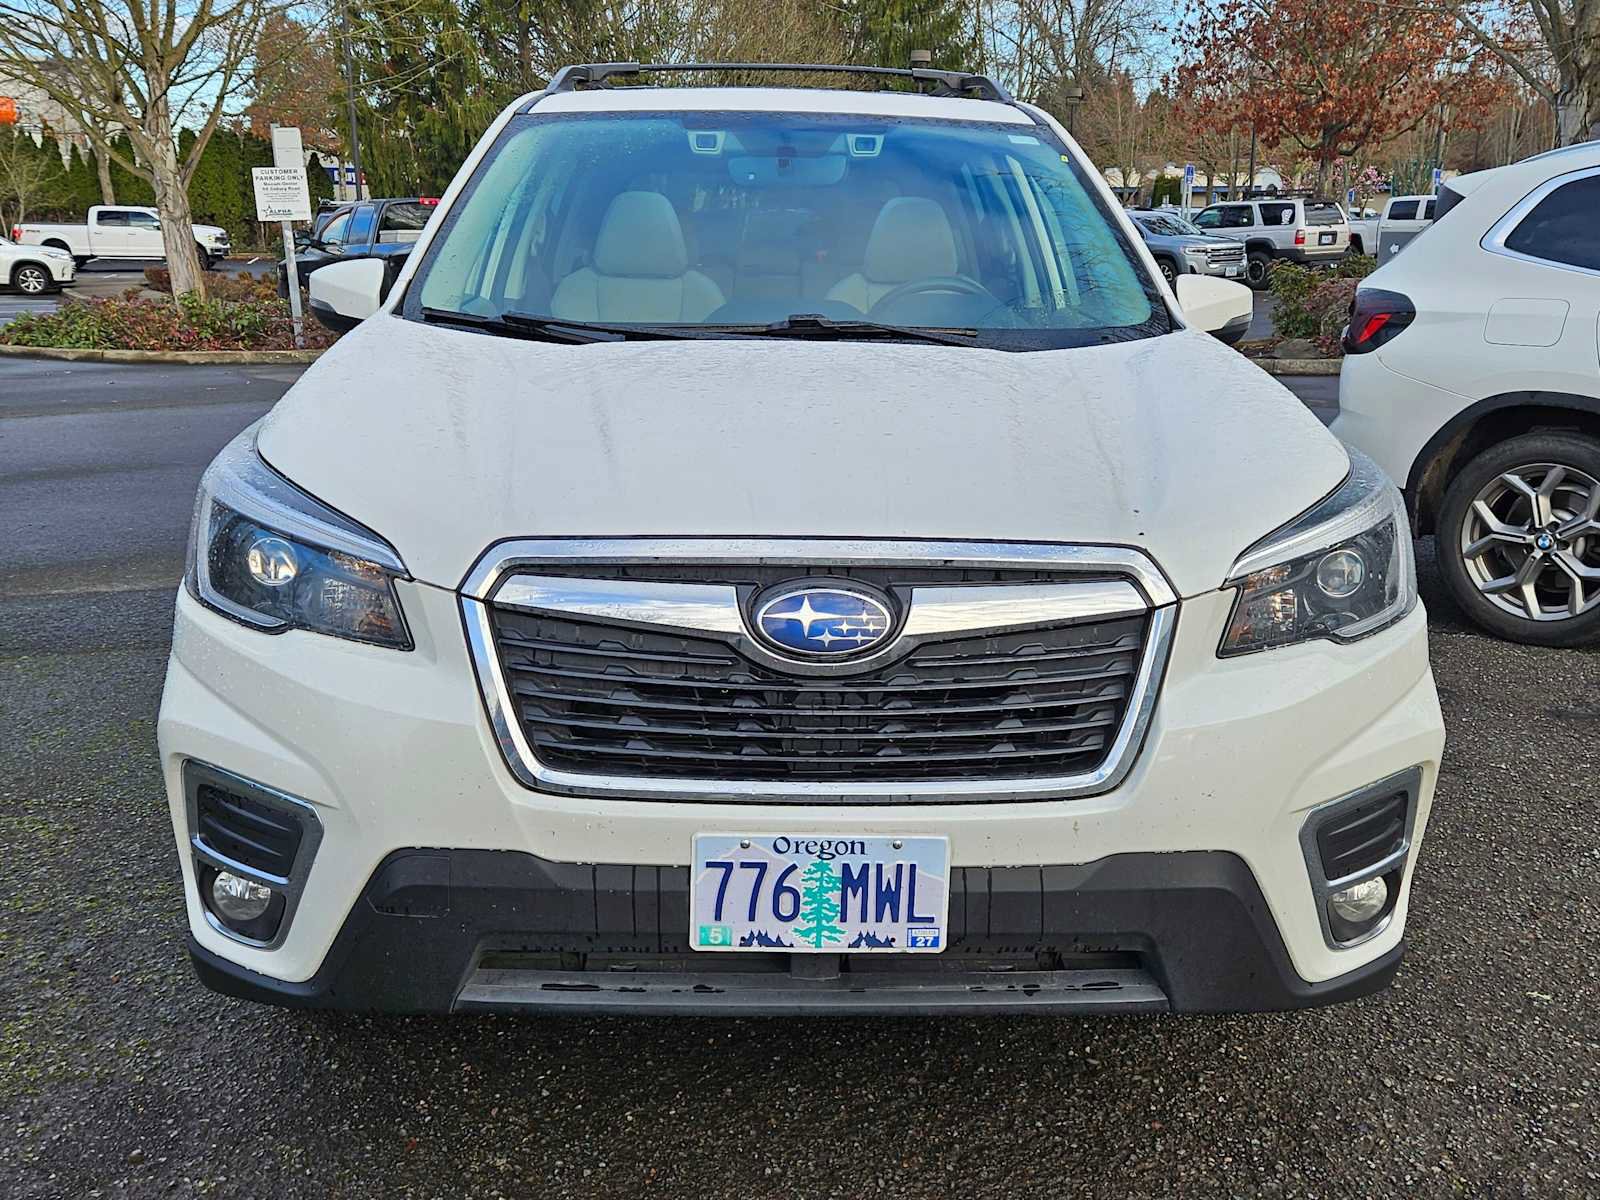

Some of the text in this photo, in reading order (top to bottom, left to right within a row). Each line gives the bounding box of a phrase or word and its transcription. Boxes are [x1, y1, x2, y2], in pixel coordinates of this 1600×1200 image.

[772, 836, 867, 860] Oregon
[705, 861, 935, 924] 776 MWL
[915, 936, 934, 947] 27
